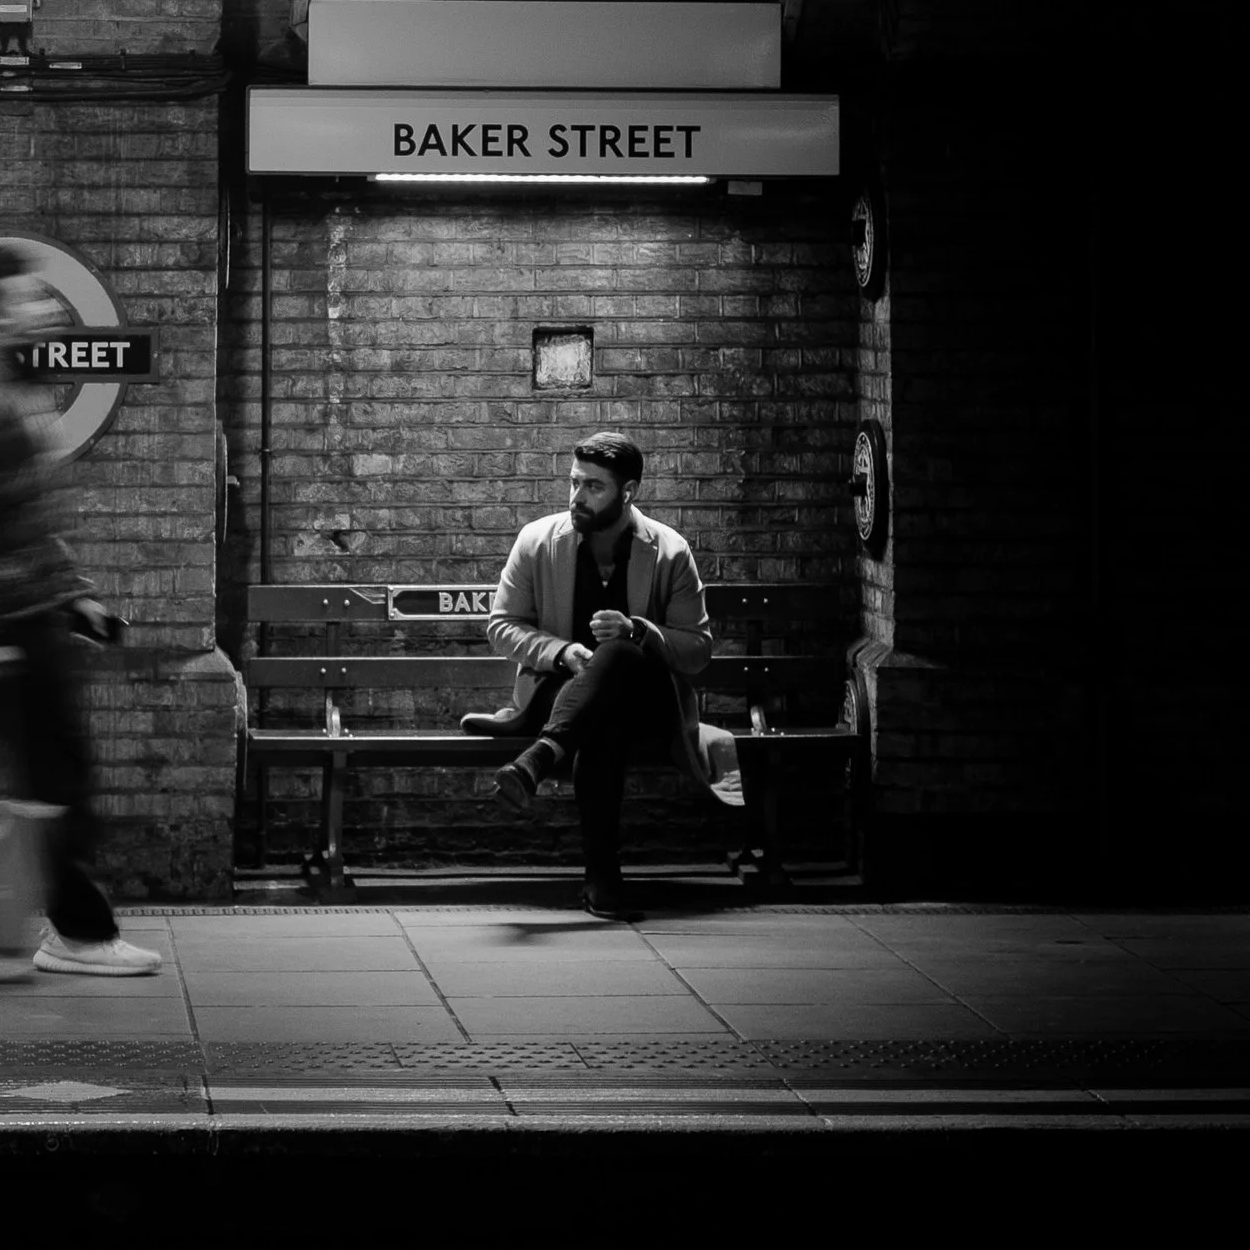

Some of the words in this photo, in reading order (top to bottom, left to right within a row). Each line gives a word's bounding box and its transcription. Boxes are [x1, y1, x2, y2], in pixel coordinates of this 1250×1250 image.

[394, 123, 532, 157] BAKER
[547, 124, 702, 159] STREET
[14, 341, 131, 368] TREET
